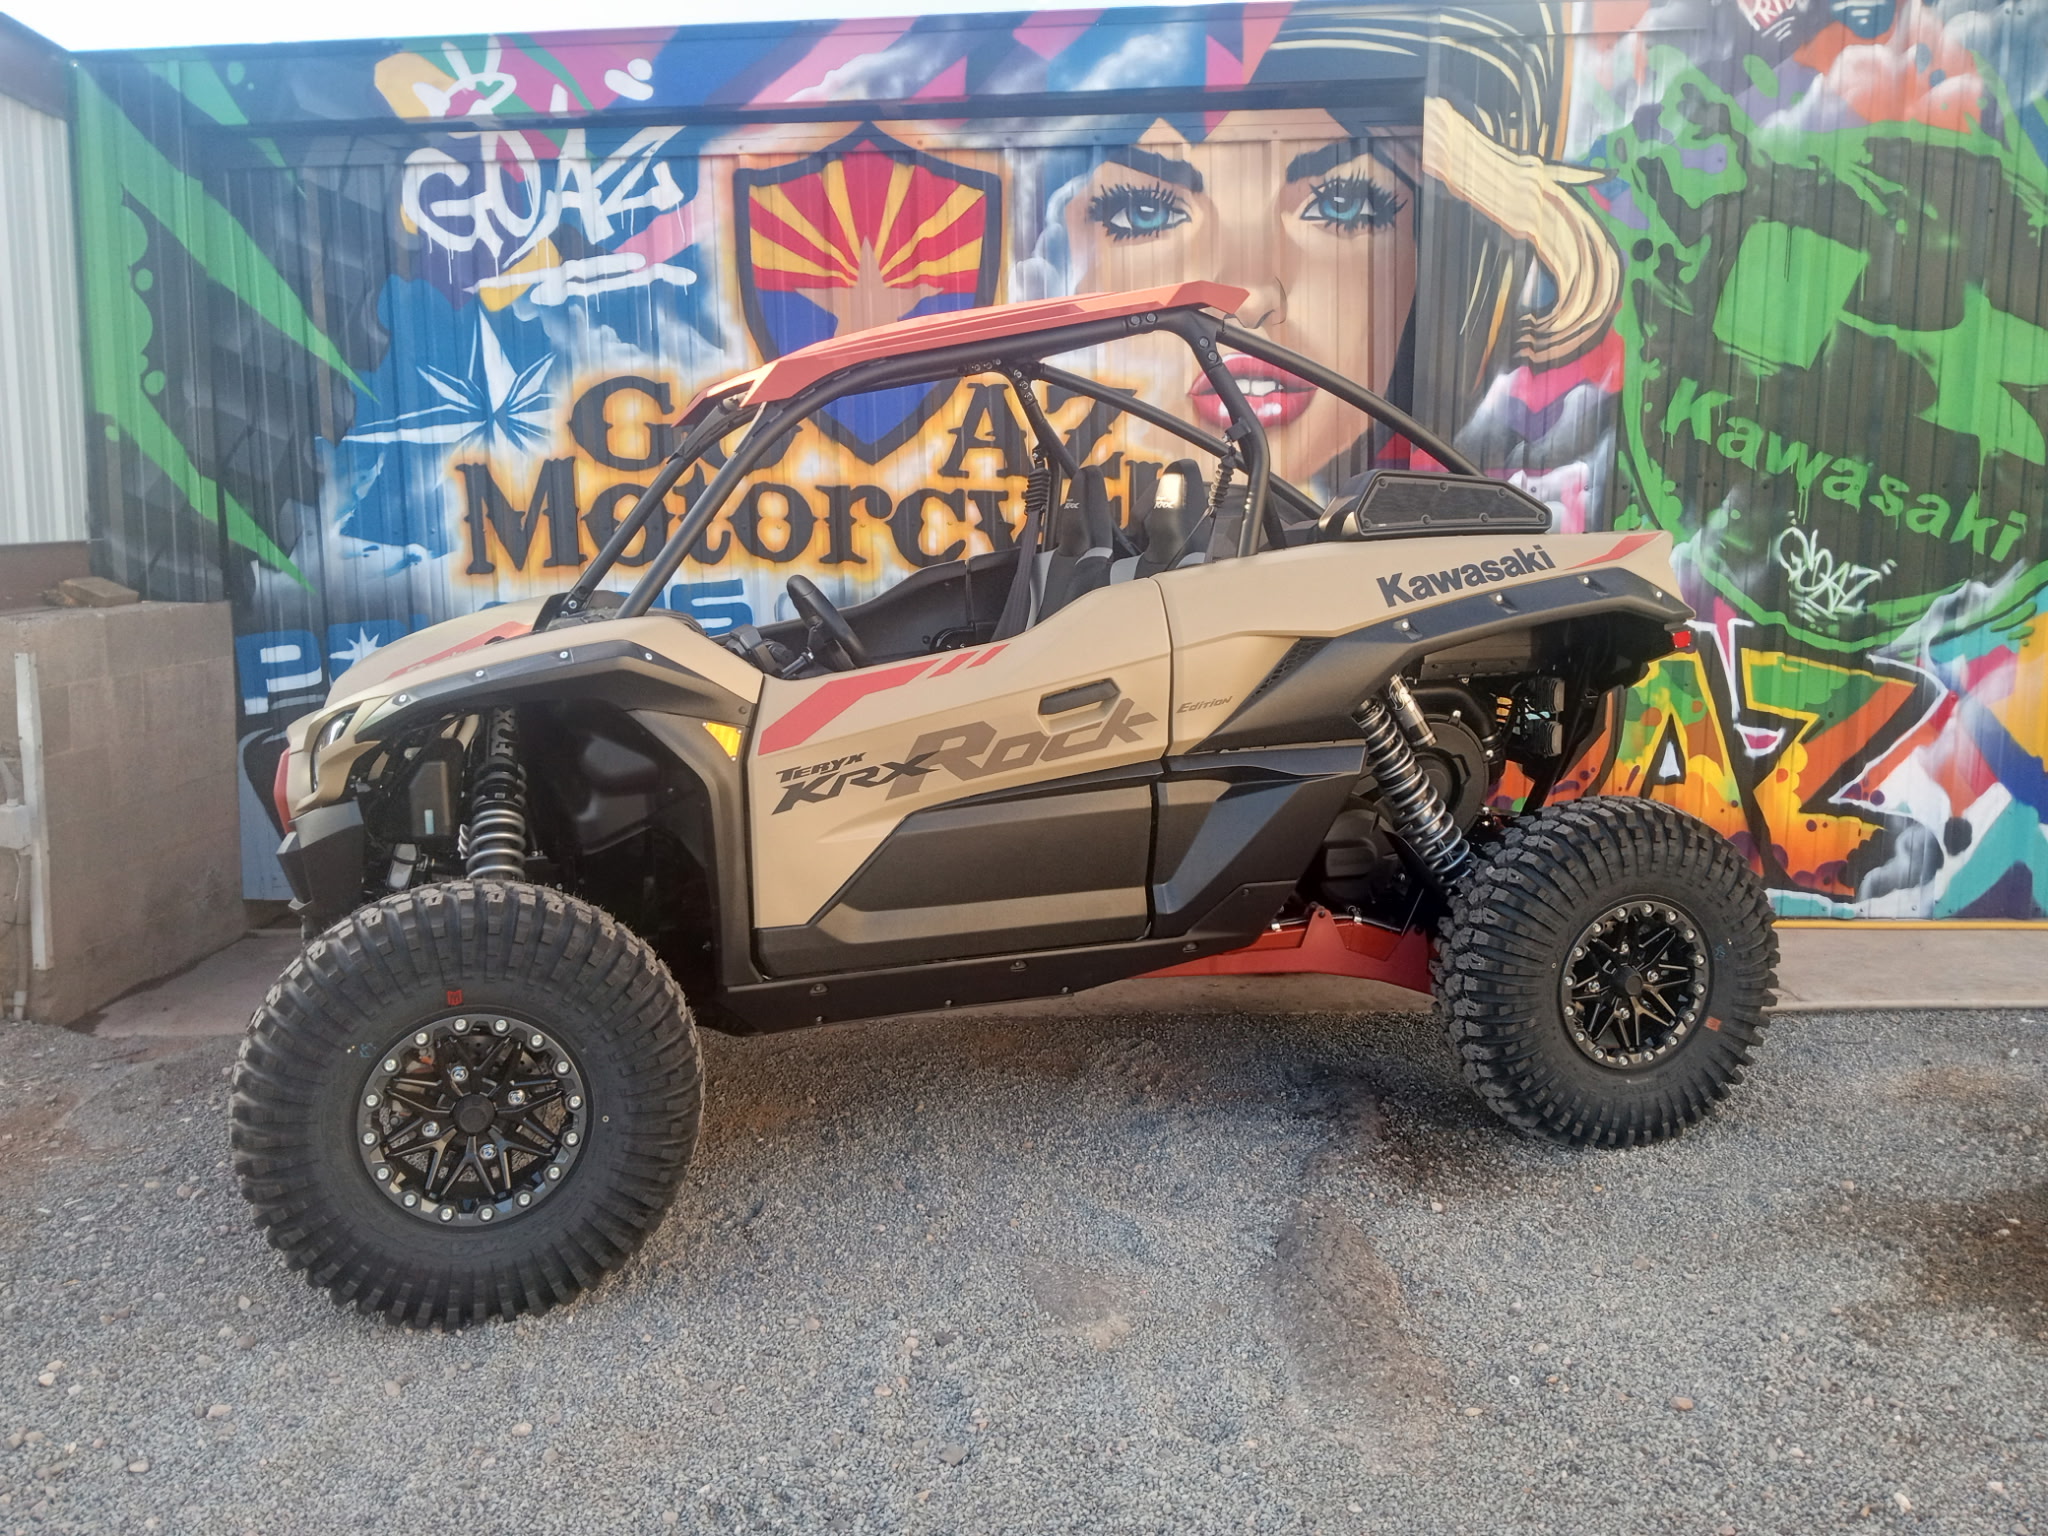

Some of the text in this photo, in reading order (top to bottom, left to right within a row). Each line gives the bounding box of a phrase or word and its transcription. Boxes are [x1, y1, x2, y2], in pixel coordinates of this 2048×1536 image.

[1661, 377, 2028, 562] Kawasaki
[1376, 544, 1556, 607] Kawasaki
[1176, 695, 1233, 714] Edition
[771, 750, 940, 815] KRX
[776, 752, 867, 783] TERYX
